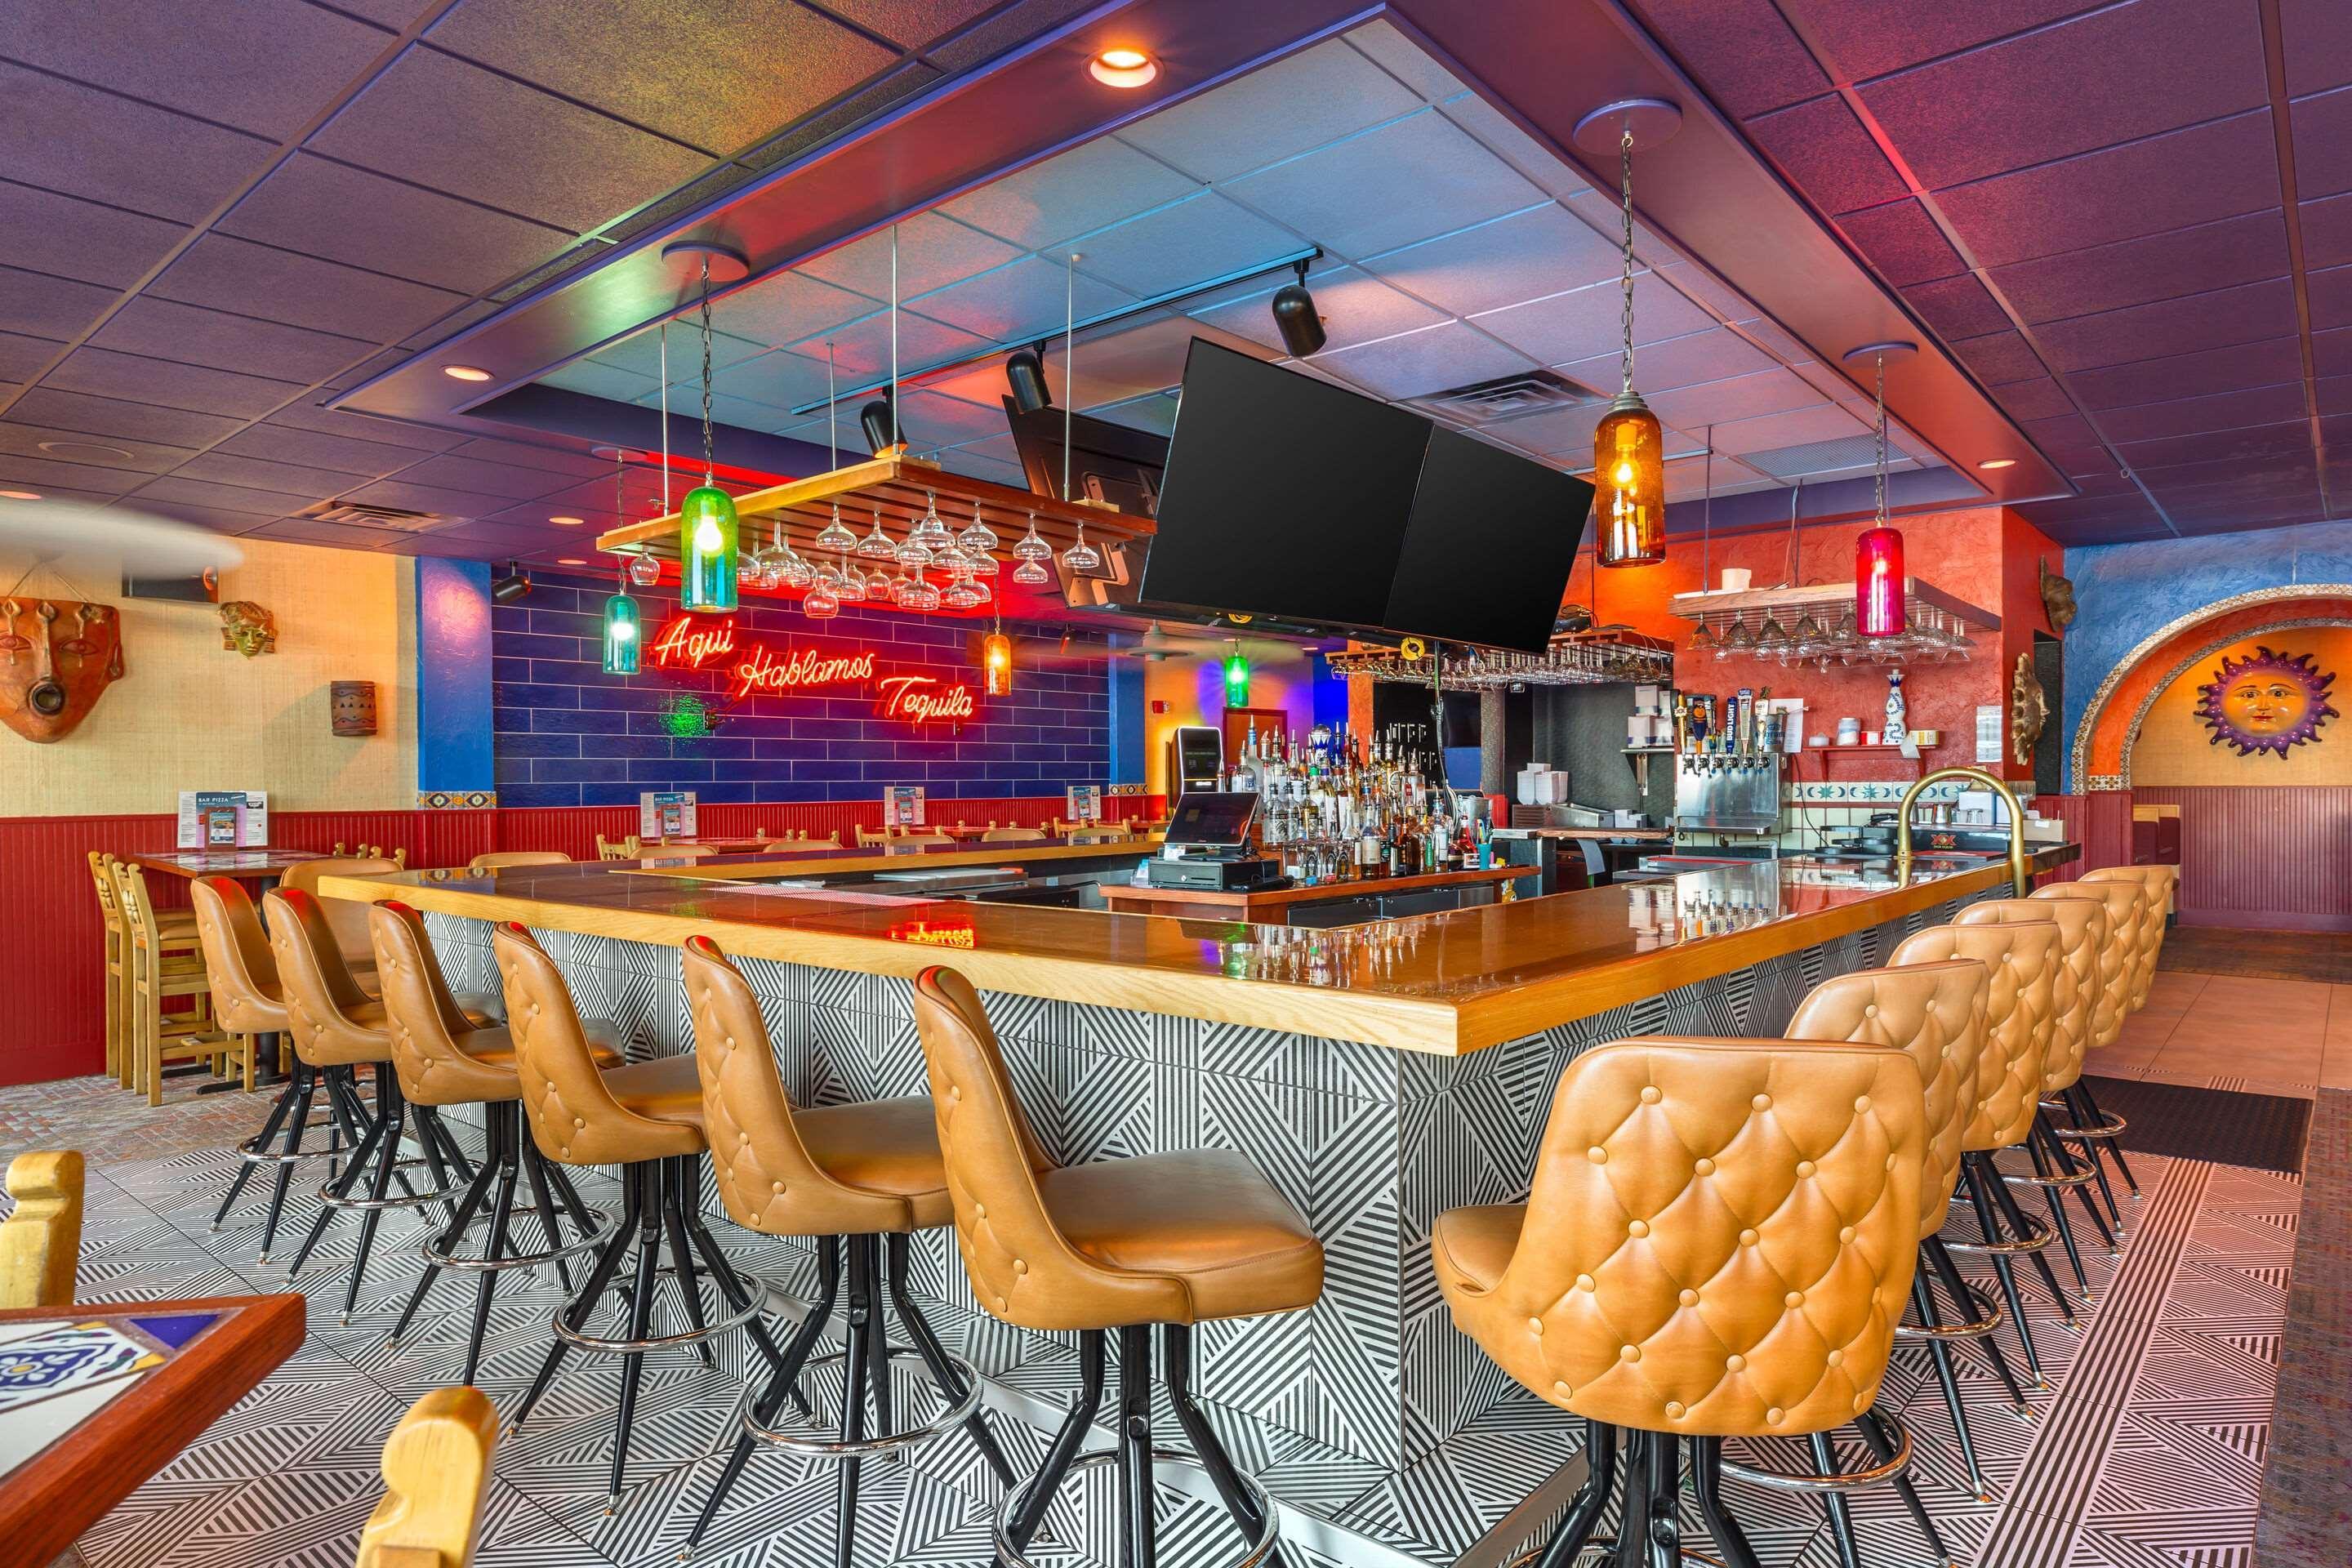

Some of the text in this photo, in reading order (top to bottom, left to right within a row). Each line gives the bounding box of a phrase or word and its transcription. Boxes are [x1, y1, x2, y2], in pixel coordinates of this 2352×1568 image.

[739, 646, 875, 697] Hablamos
[880, 676, 973, 724] Tequila
[1931, 834, 1958, 846] XX
